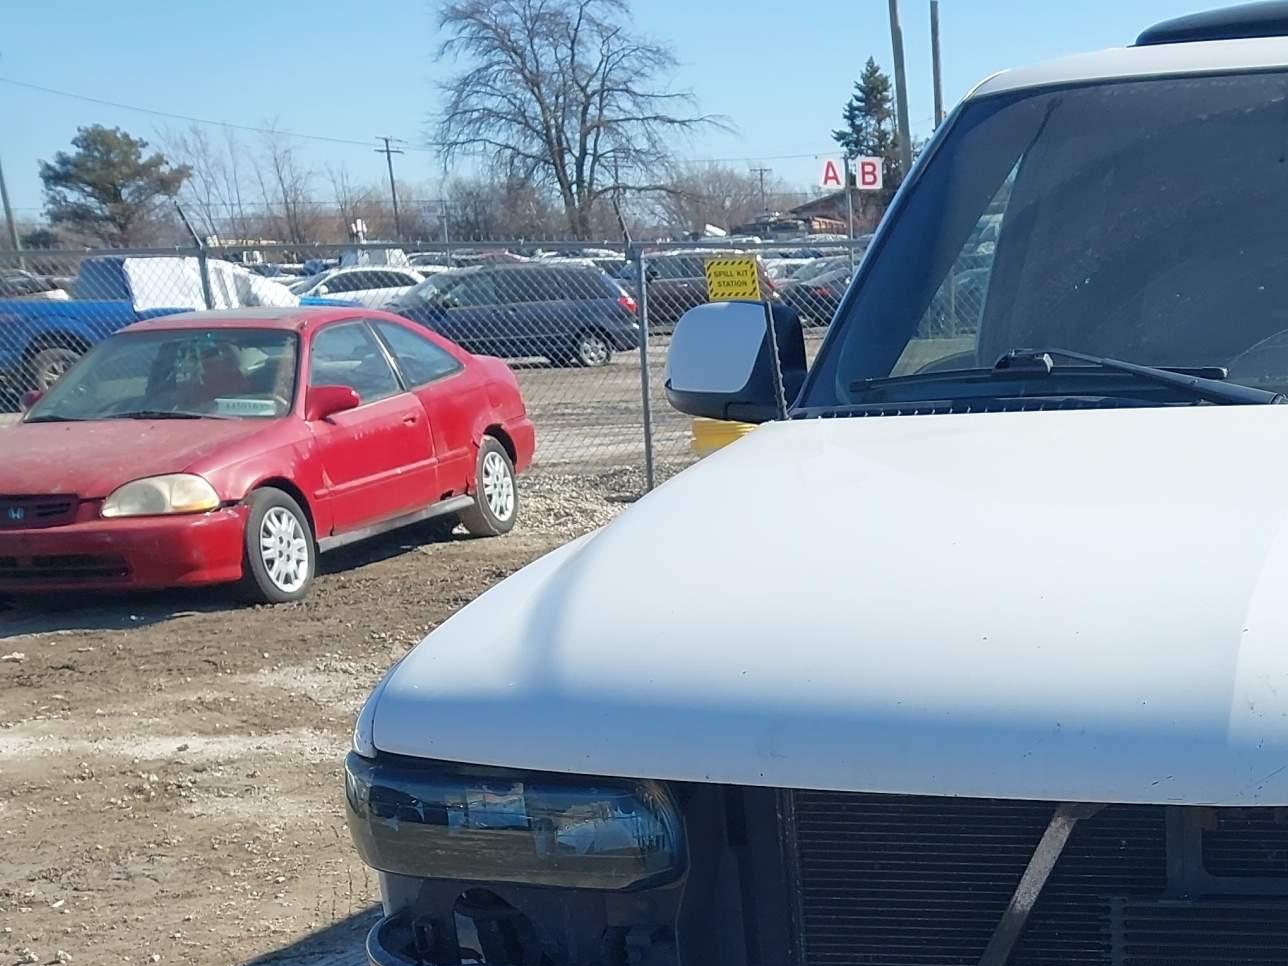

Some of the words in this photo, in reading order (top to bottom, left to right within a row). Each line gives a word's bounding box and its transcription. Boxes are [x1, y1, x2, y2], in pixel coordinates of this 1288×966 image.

[823, 161, 841, 185] A
[861, 161, 878, 186] B
[713, 270, 733, 278] SPILL
[716, 280, 748, 288] STATION
